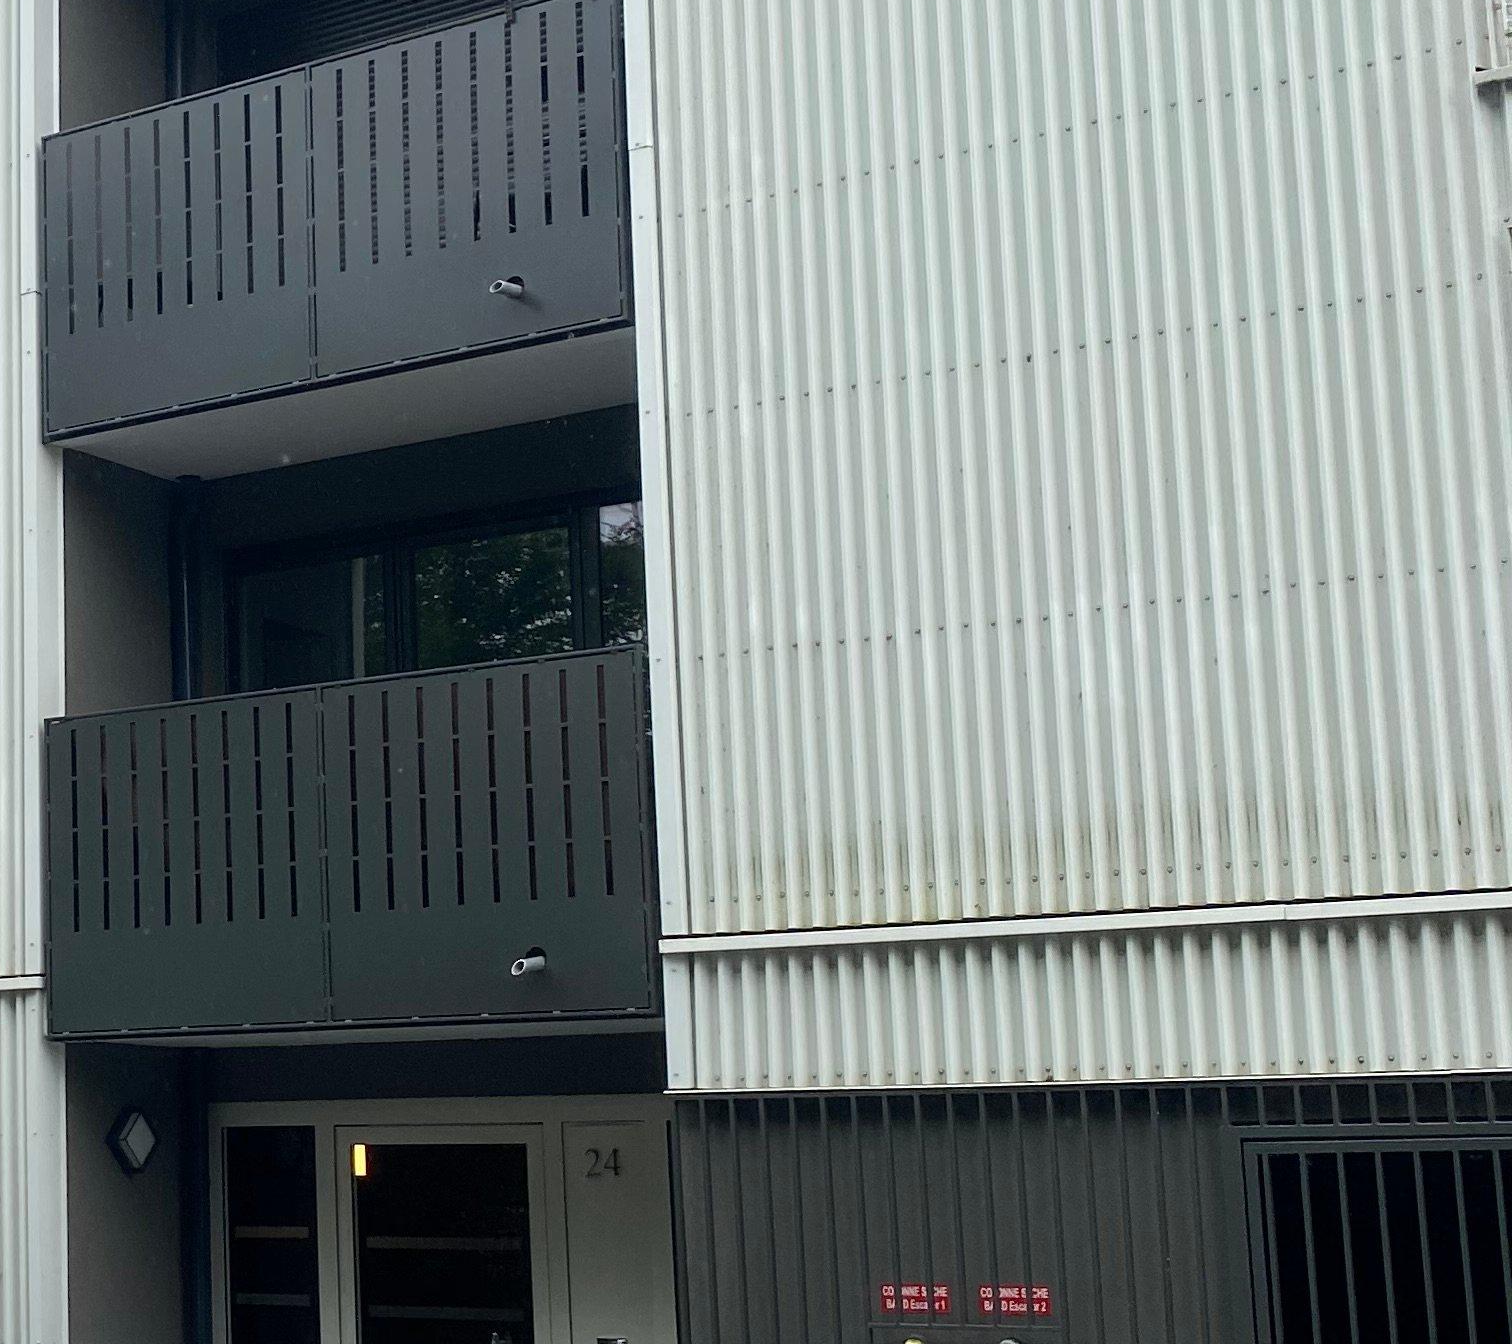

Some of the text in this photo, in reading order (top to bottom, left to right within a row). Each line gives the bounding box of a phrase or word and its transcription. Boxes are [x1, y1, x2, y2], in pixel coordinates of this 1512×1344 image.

[584, 1147, 621, 1178] 24
[882, 1285, 920, 1297] CONNE
[980, 1287, 1020, 1298] CONNE
[910, 1299, 940, 1310] Escar
[1009, 1301, 1040, 1312] Escar
